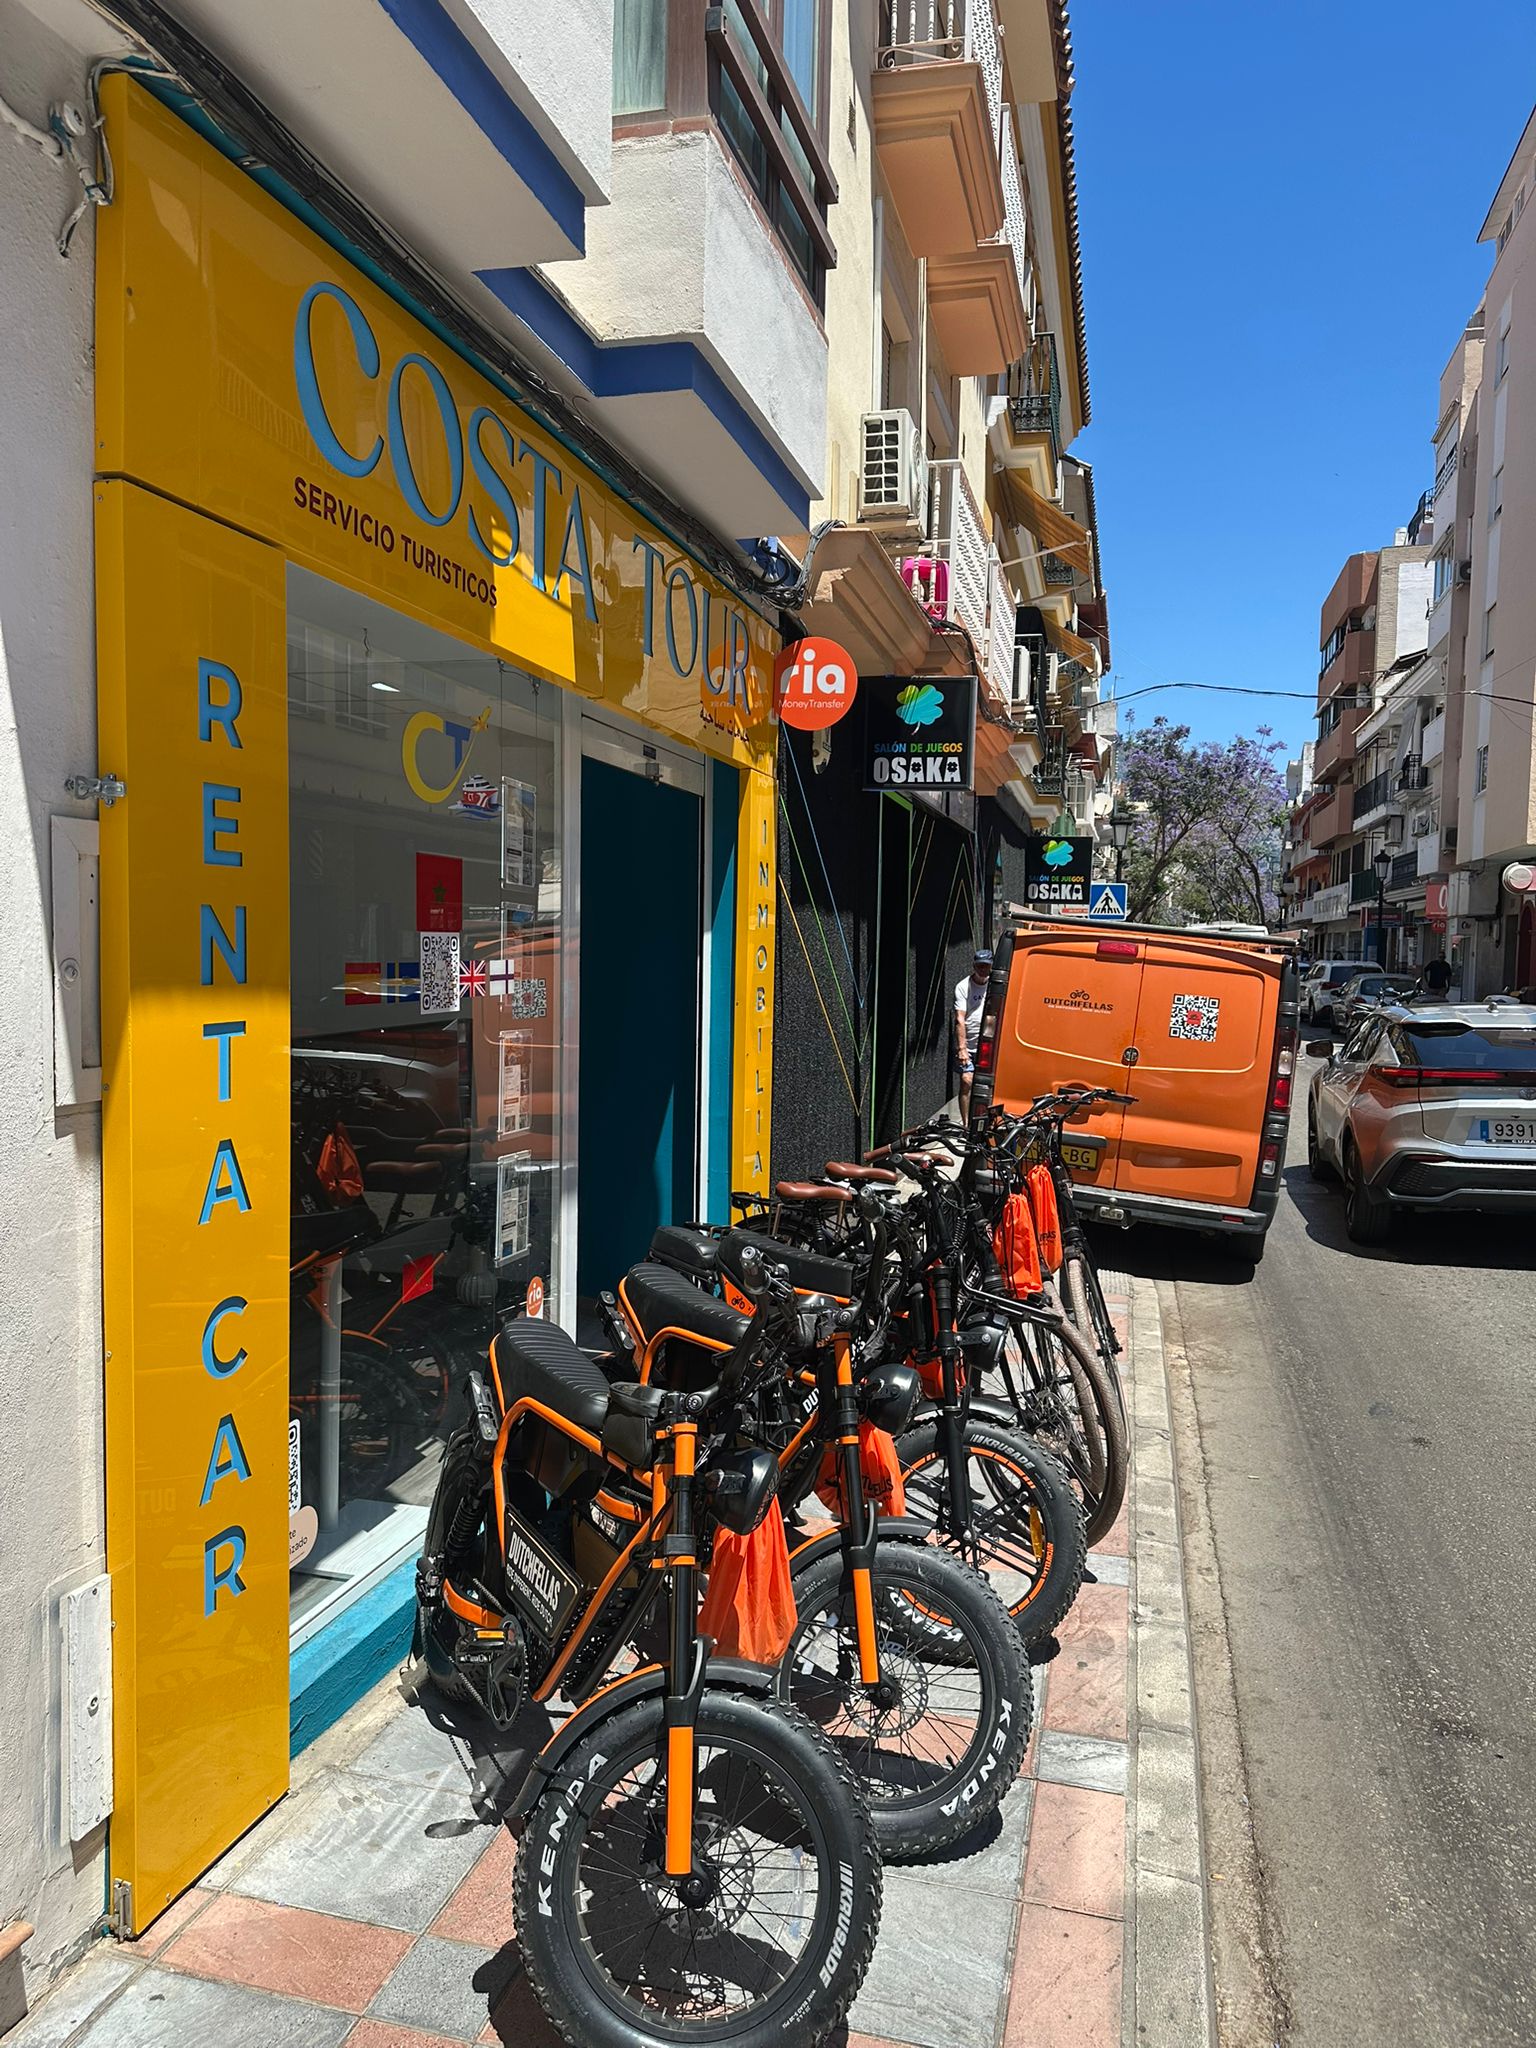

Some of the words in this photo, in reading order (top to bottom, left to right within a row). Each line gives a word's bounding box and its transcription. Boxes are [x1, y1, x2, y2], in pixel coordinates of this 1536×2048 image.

[294, 281, 599, 624] COSTA
[633, 533, 752, 716] TOUR
[293, 476, 395, 554] SERVICIO
[400, 533, 498, 609] TURISTICOS
[780, 648, 846, 694] ria
[873, 756, 962, 784] OSAKA
[874, 741, 907, 753] SALÓN
[910, 742, 923, 753] DE
[925, 742, 963, 753] JUEGOS
[198, 656, 248, 1102] RENT
[1027, 883, 1083, 900] OSAKA
[1043, 997, 1114, 1011] DUTCHFELLAS
[1494, 1123, 1534, 1137] 9391
[1064, 1148, 1091, 1164] -BG
[198, 1138, 252, 1225] A
[528, 1282, 542, 1305] ria
[198, 1295, 252, 1619] CAR
[982, 1437, 1036, 1470] KRUSADE
[289, 1536, 308, 1555] izado
[508, 1531, 561, 1612] DUTCHFELLAS
[939, 1697, 1013, 1817] KENDA
[538, 1753, 609, 1917] KENDA
[818, 1885, 854, 1989] KRUSADE
